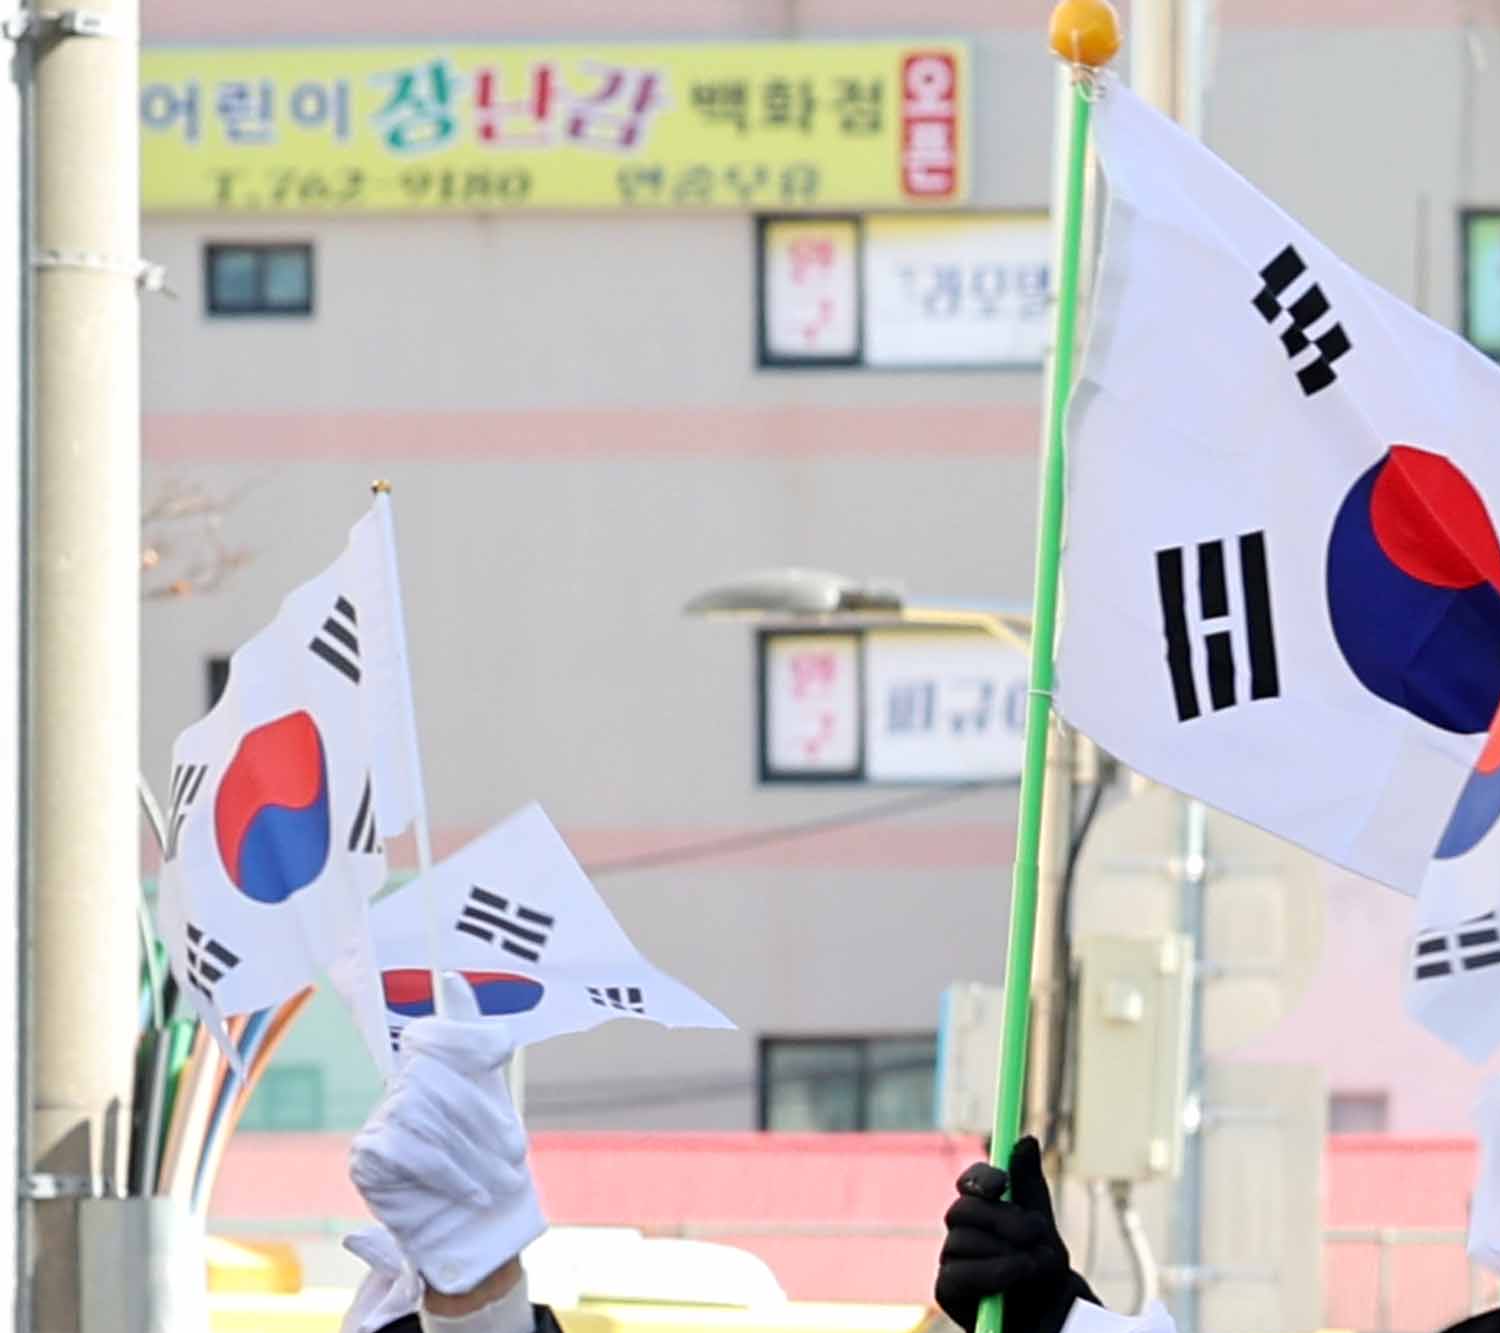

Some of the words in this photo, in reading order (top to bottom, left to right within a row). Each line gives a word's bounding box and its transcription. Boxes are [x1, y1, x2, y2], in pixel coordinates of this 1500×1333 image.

[140, 78, 351, 143] 어린이
[374, 58, 668, 149] 장난감
[690, 73, 886, 135] 백화점
